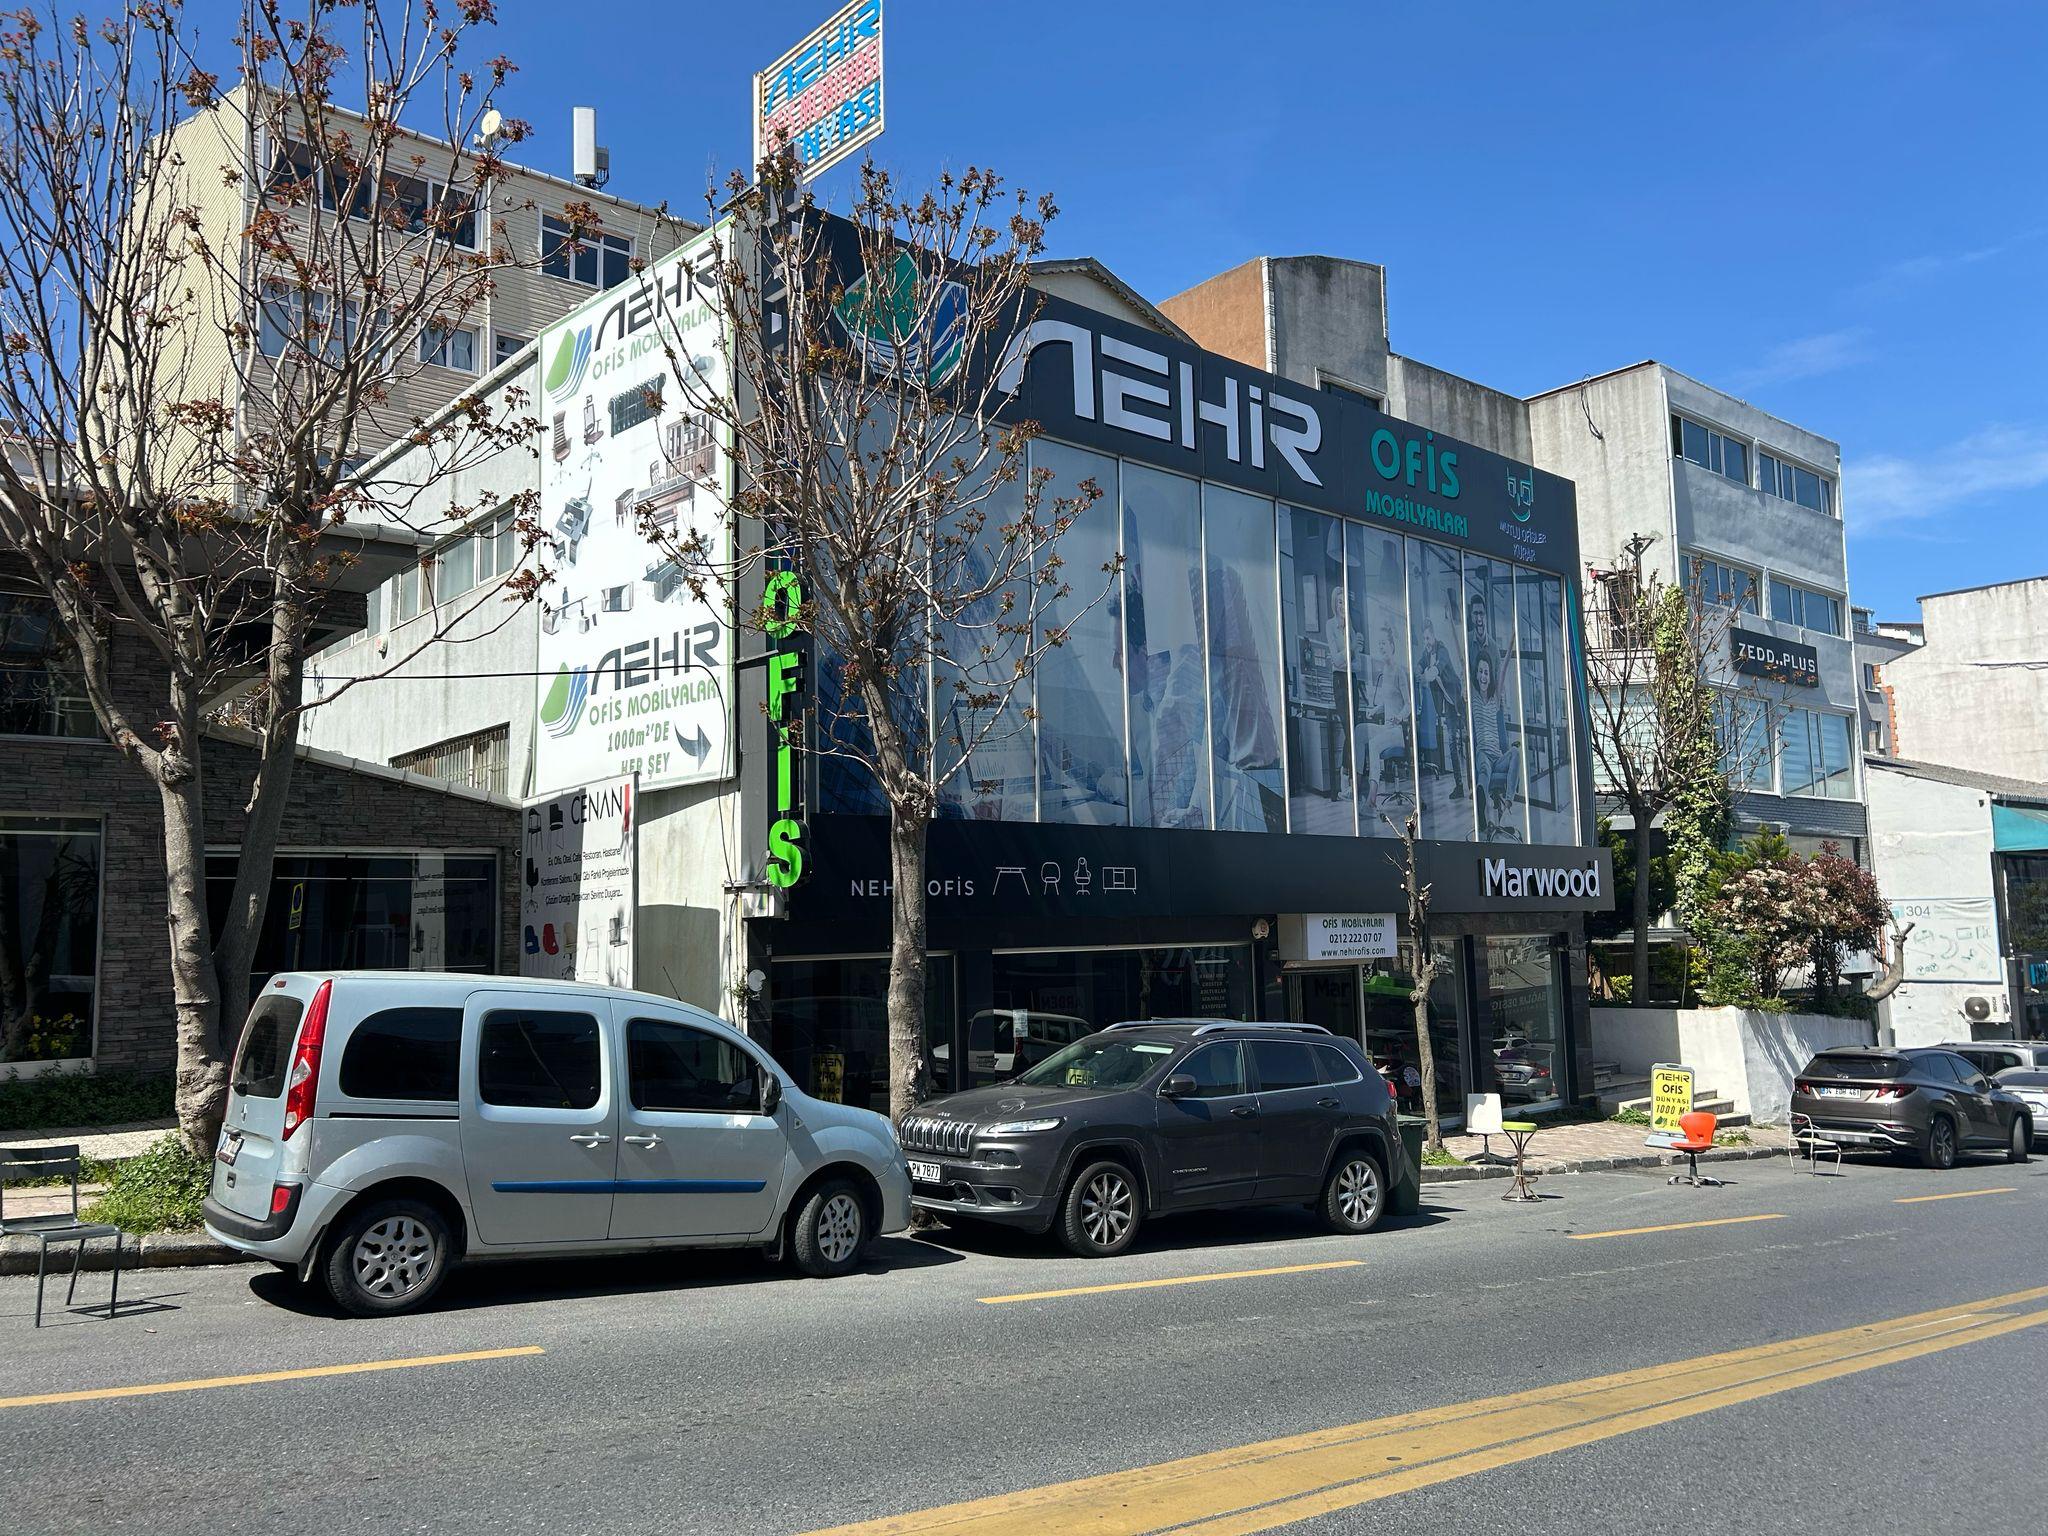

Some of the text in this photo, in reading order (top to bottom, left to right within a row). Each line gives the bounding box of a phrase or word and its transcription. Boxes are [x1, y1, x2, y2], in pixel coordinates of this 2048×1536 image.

[795, 80, 881, 163] NYASI
[998, 319, 1323, 487] NEHİR
[1365, 489, 1469, 538] MOBİLYALARI
[590, 621, 721, 695] NEHİR
[589, 676, 721, 726] OFİS MOBİLYALARI
[648, 752, 670, 780] ŞEY
[571, 785, 623, 824] CENAN
[928, 876, 975, 896] OFİS
[1484, 858, 1600, 898] Marwood
[1322, 917, 1385, 929] OFİS MOBİLYALARI
[1906, 905, 1931, 917] 304
[1329, 932, 1382, 943] 0212 222 07 07
[1321, 946, 1386, 957] www.nehirofis.com
[1655, 1073, 1690, 1083] NEHİR
[1656, 1105, 1676, 1115] 1000
[922, 1164, 940, 1178] 7877
